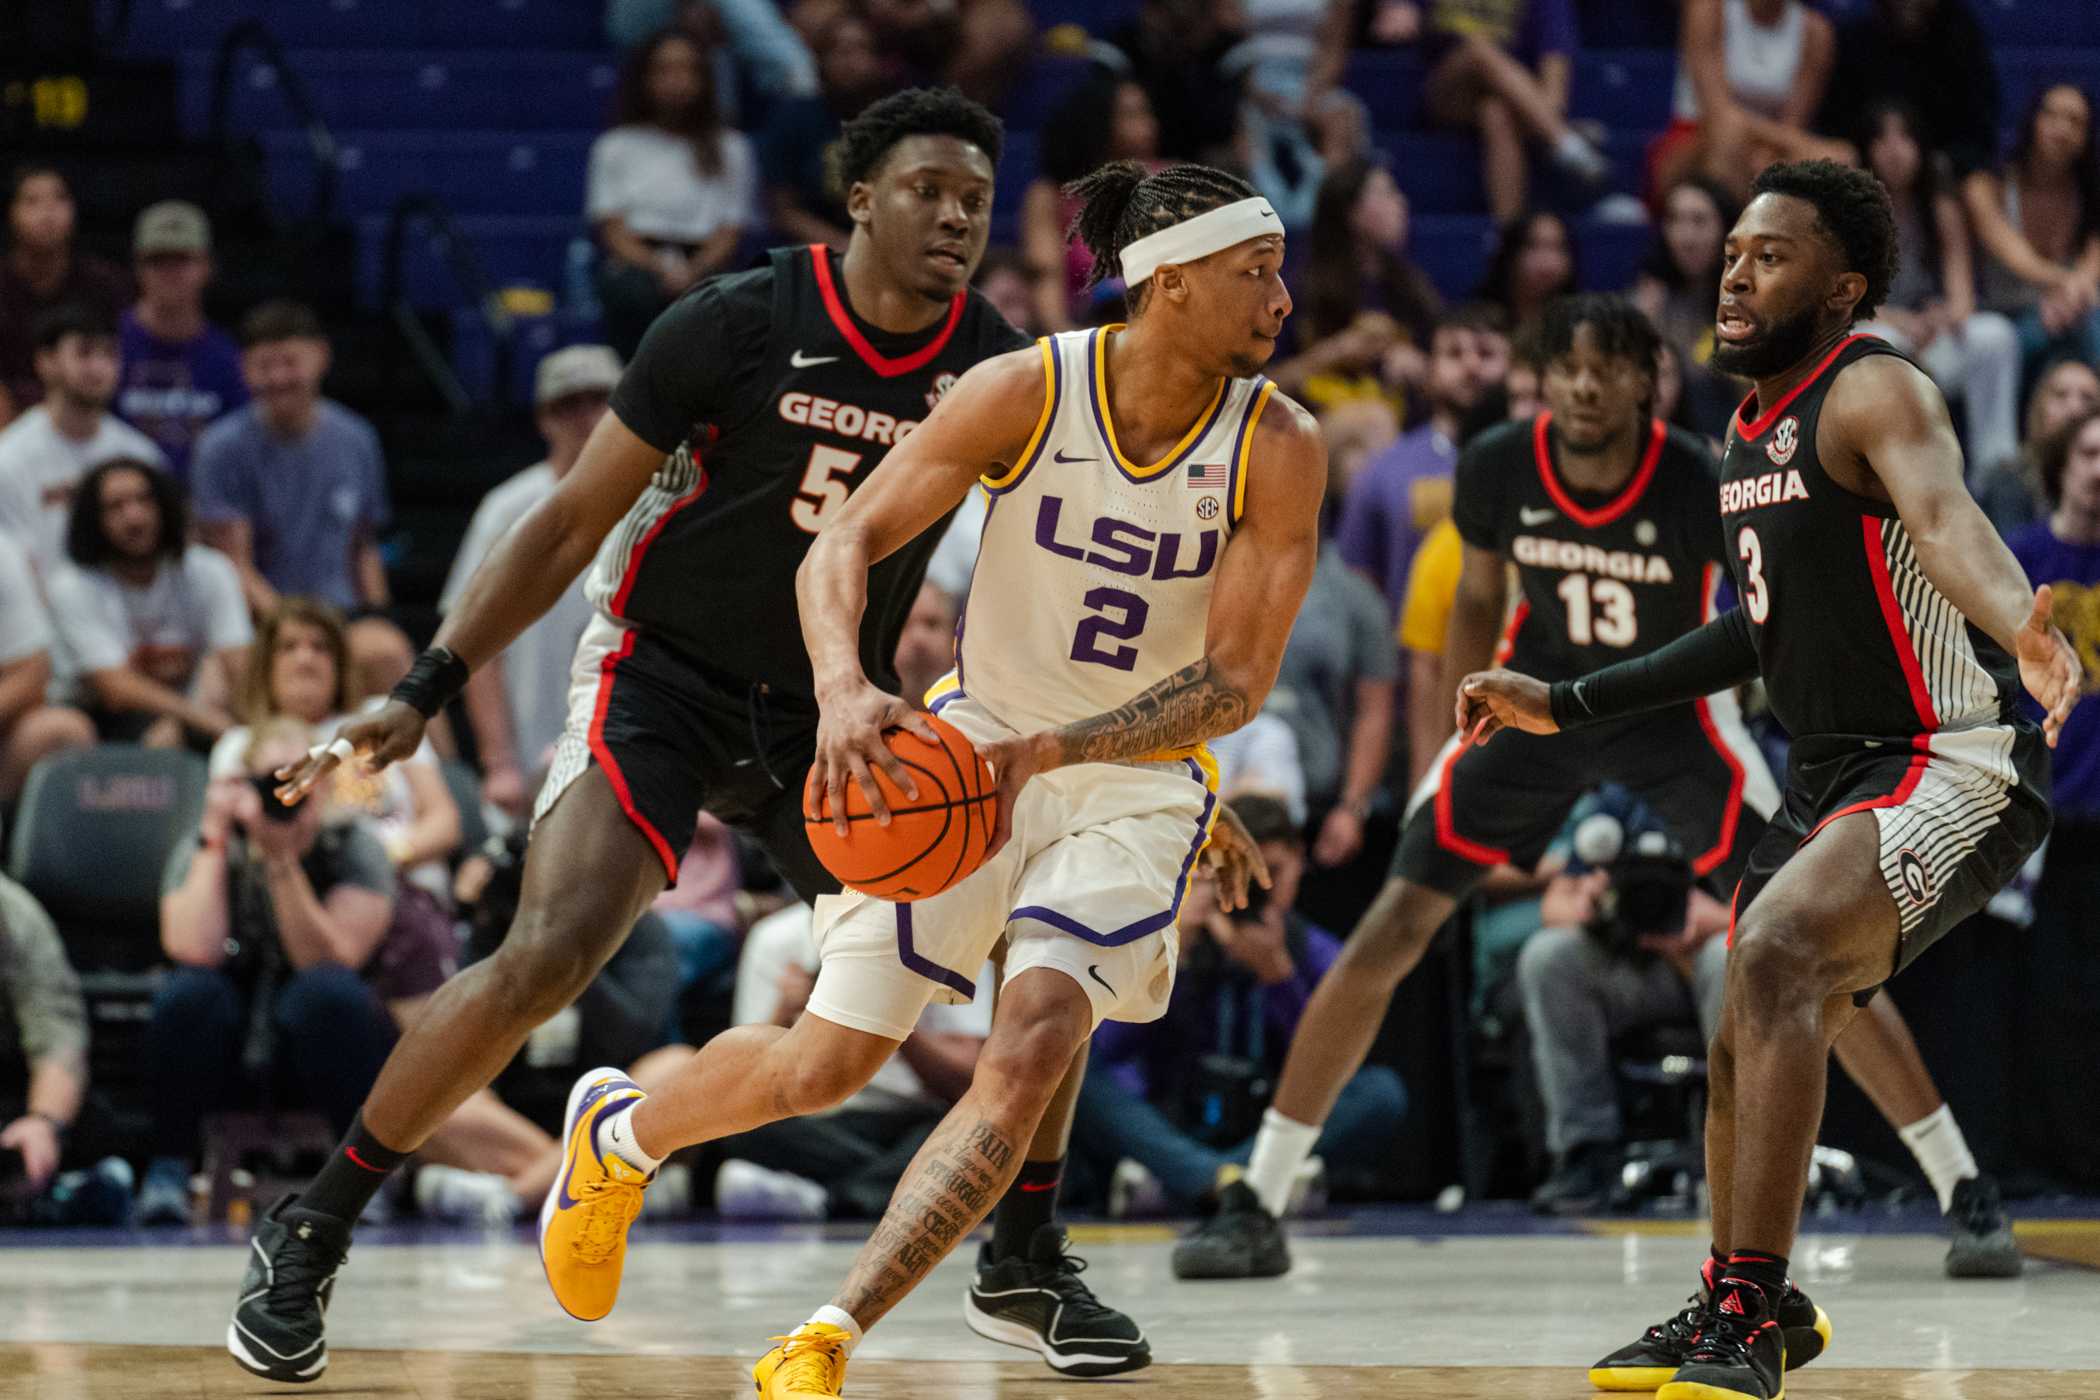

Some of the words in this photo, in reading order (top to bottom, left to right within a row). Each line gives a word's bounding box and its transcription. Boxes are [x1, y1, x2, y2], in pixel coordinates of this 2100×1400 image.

[789, 443, 863, 534] 5
[1198, 497, 1218, 519] SEC
[1719, 469, 1811, 516] EORGIA
[1035, 495, 1218, 580] LSU
[1512, 534, 1674, 584] GEORGIA
[1738, 524, 1770, 625] 3
[1070, 586, 1149, 672] 2
[1556, 571, 1638, 648] 13
